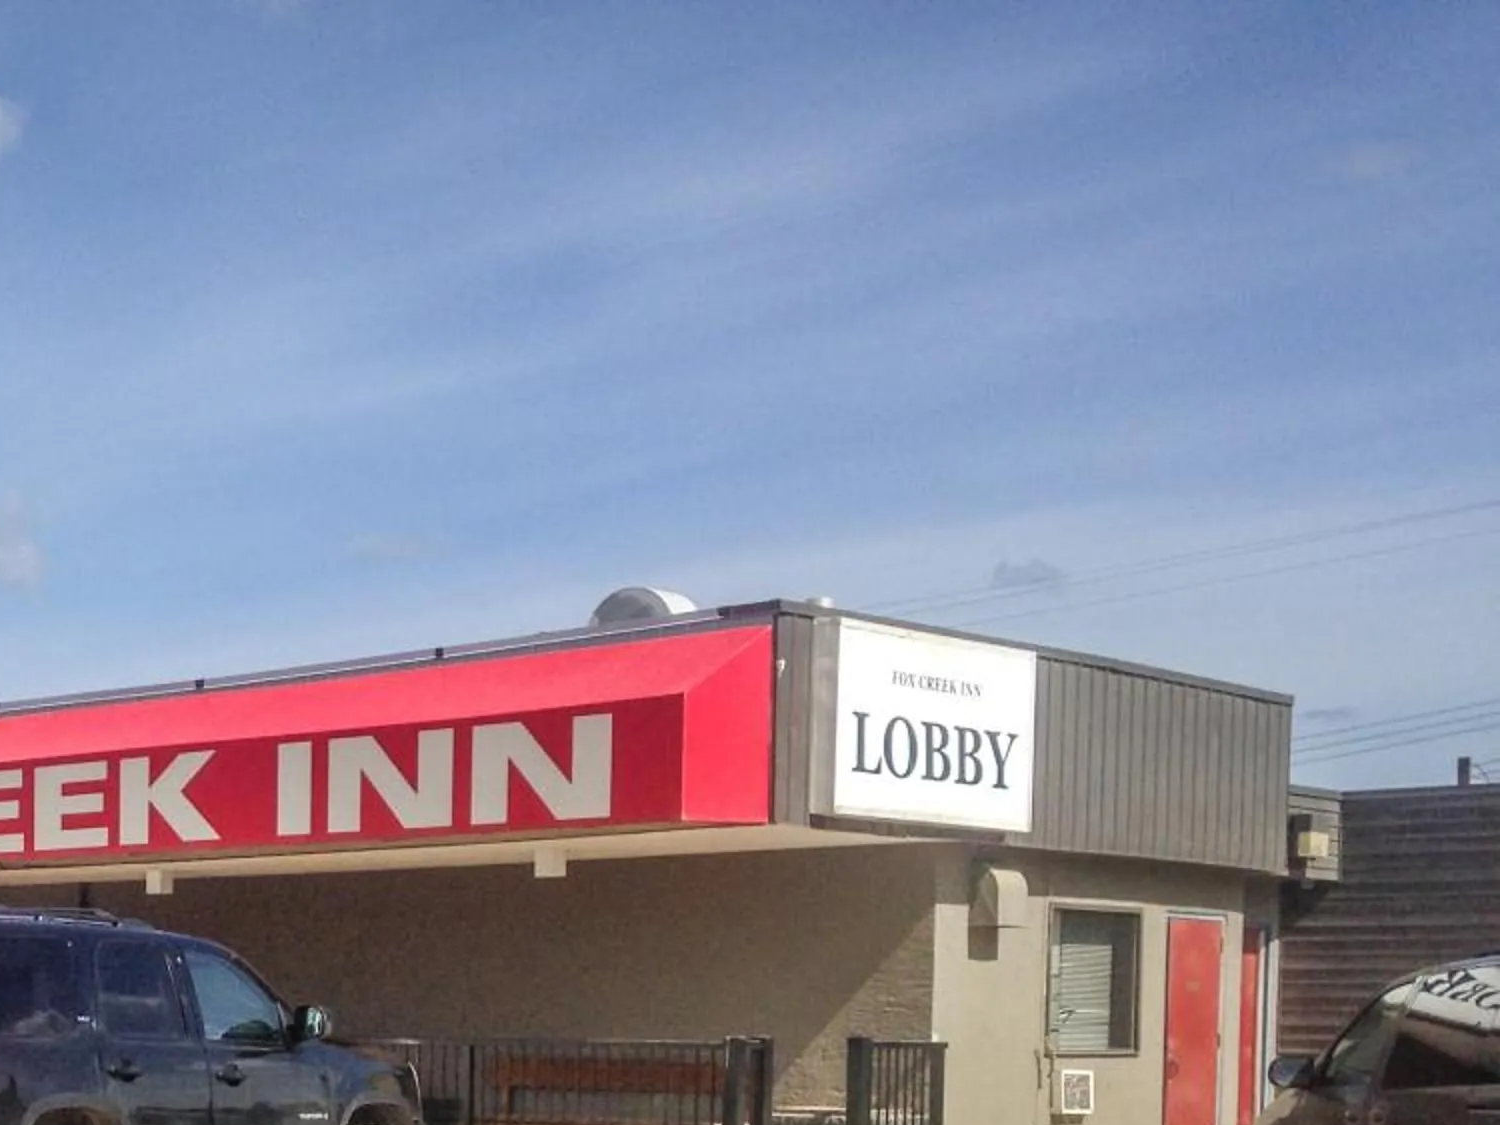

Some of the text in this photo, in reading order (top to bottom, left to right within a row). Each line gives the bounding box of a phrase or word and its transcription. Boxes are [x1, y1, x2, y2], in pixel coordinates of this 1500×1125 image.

[891, 669, 983, 698] FOX CREEK INN
[276, 712, 613, 837] INN
[851, 710, 1019, 790] LOBBY
